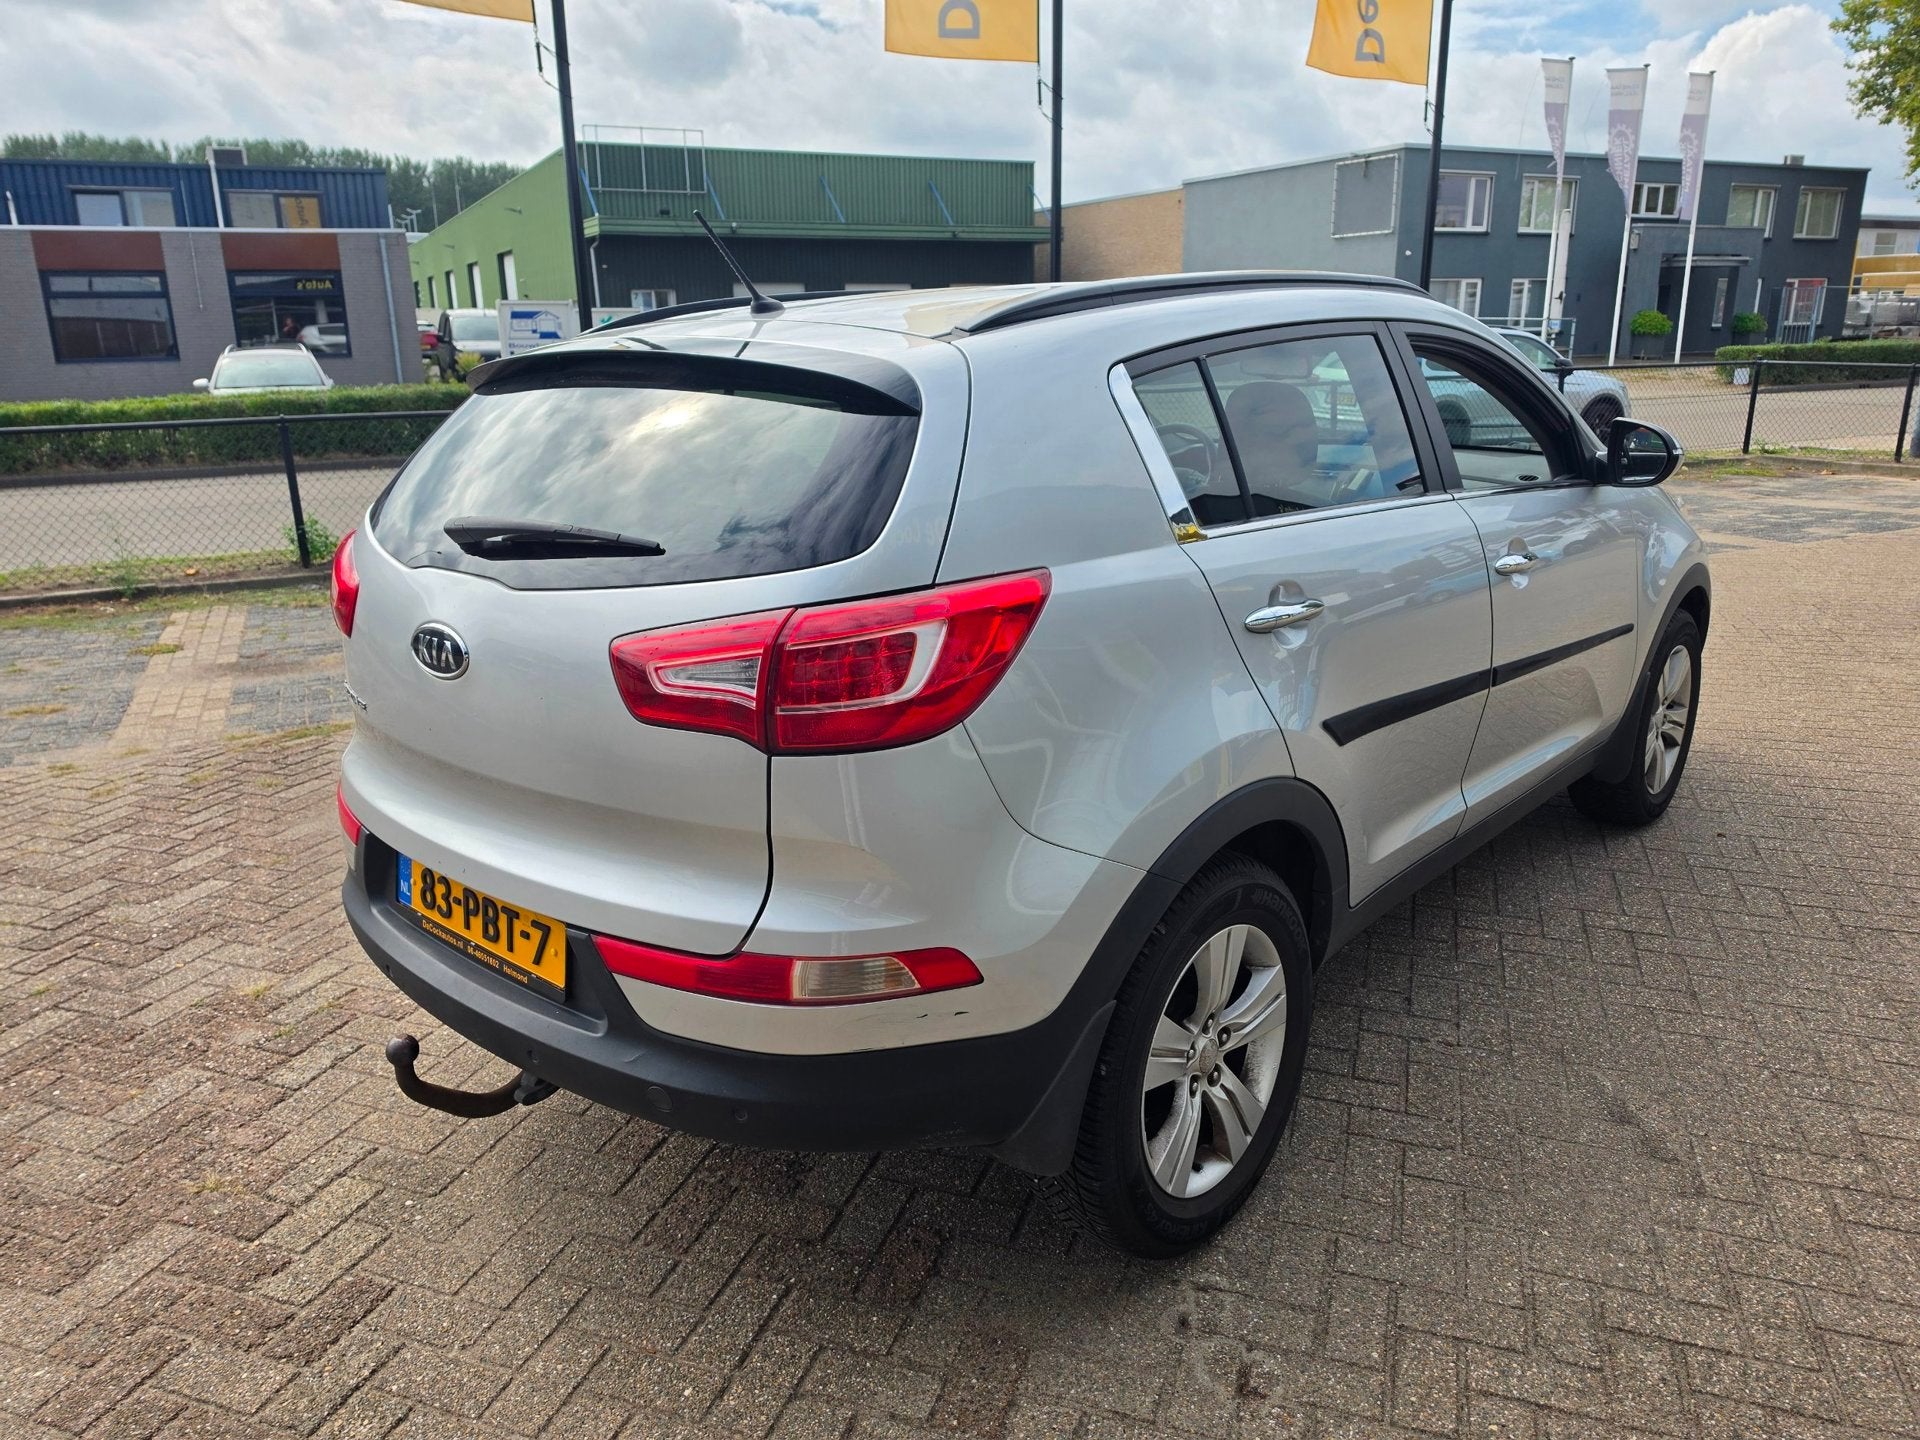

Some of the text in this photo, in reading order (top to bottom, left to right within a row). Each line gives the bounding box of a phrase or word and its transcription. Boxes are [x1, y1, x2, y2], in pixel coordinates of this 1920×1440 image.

[418, 633, 456, 670] KIA
[400, 879, 411, 897] NL
[420, 867, 552, 966] 83-PBT-7
[503, 964, 528, 989] Helmond
